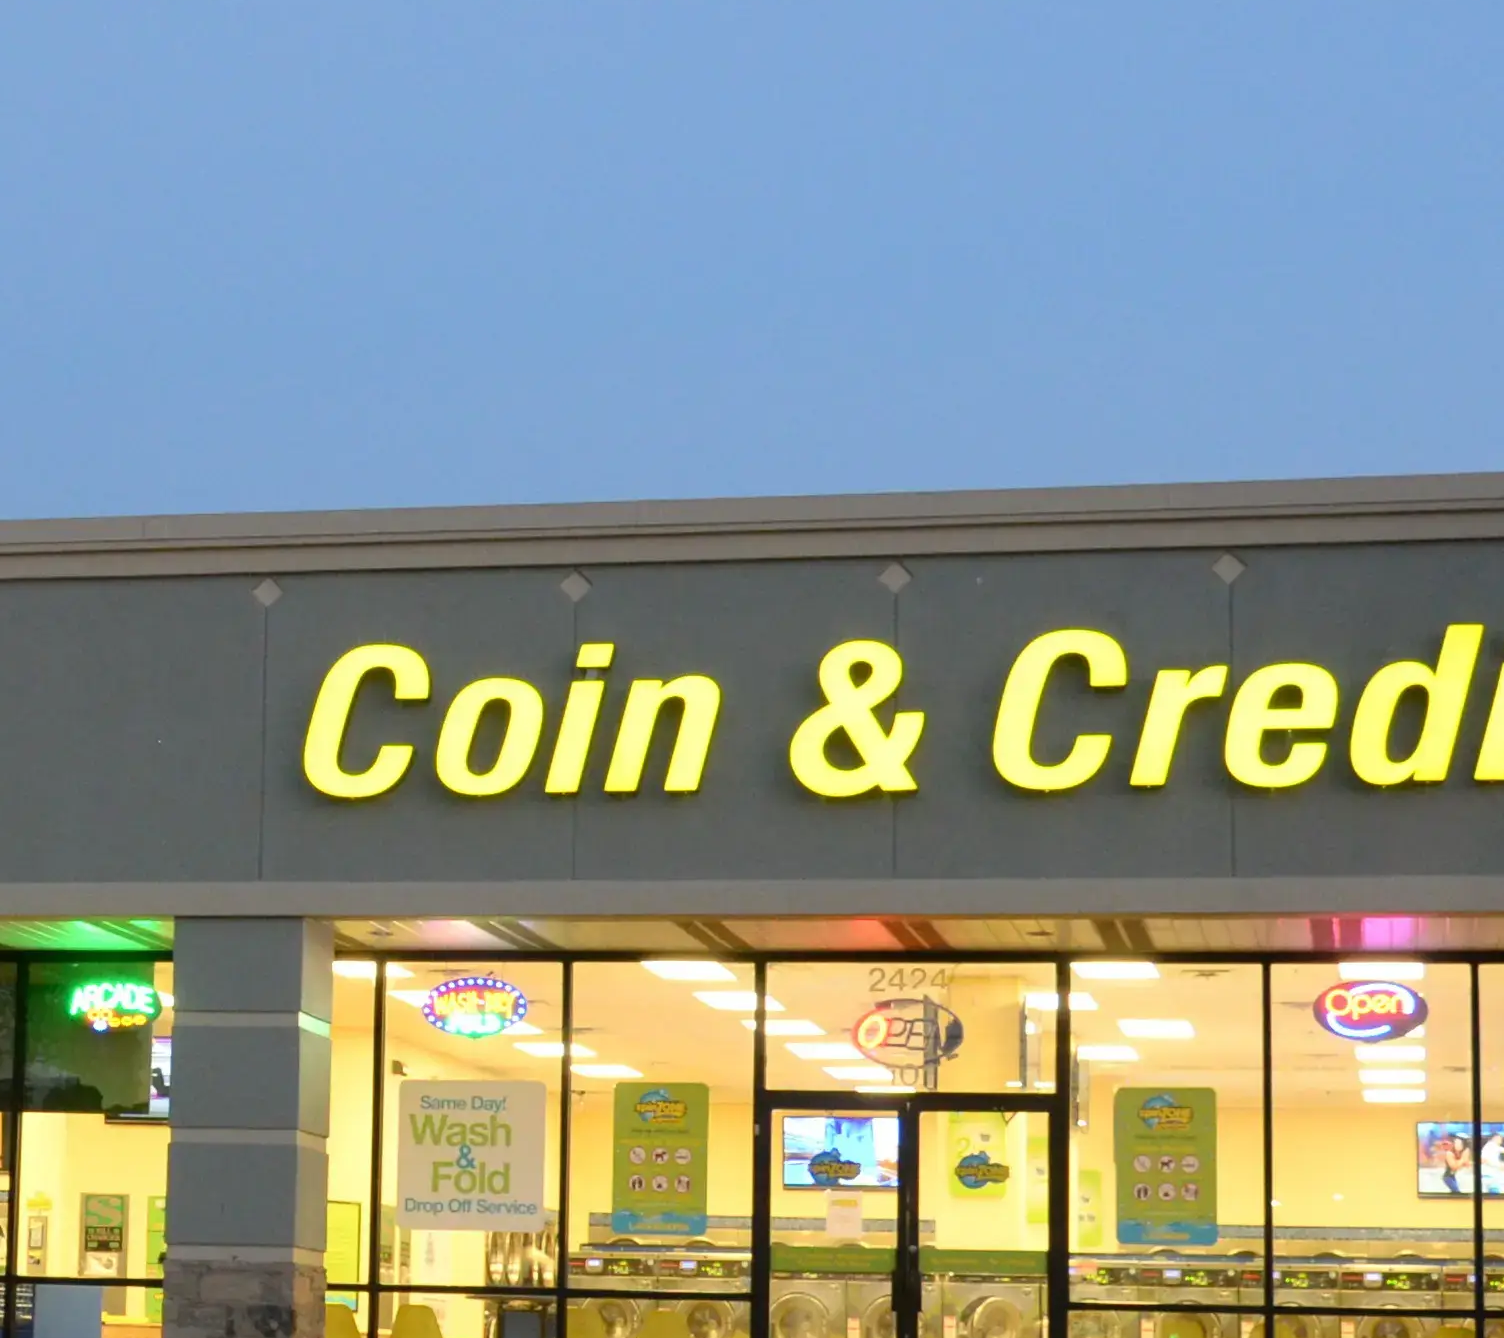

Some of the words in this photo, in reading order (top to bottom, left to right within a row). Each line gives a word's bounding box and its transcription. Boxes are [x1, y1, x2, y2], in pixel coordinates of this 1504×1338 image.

[304, 644, 720, 797] Coin
[790, 640, 924, 796] &
[868, 967, 949, 992] 2424
[70, 983, 155, 1015] ARCADE
[1325, 988, 1408, 1020] Open
[420, 1095, 467, 1110] Same
[471, 1095, 508, 1114] Day!
[408, 1114, 512, 1147] Wash
[456, 1143, 476, 1169] &
[431, 1162, 510, 1194] Fold
[405, 1198, 443, 1216] Drop
[448, 1198, 472, 1213] Off
[477, 1199, 537, 1215] Service
